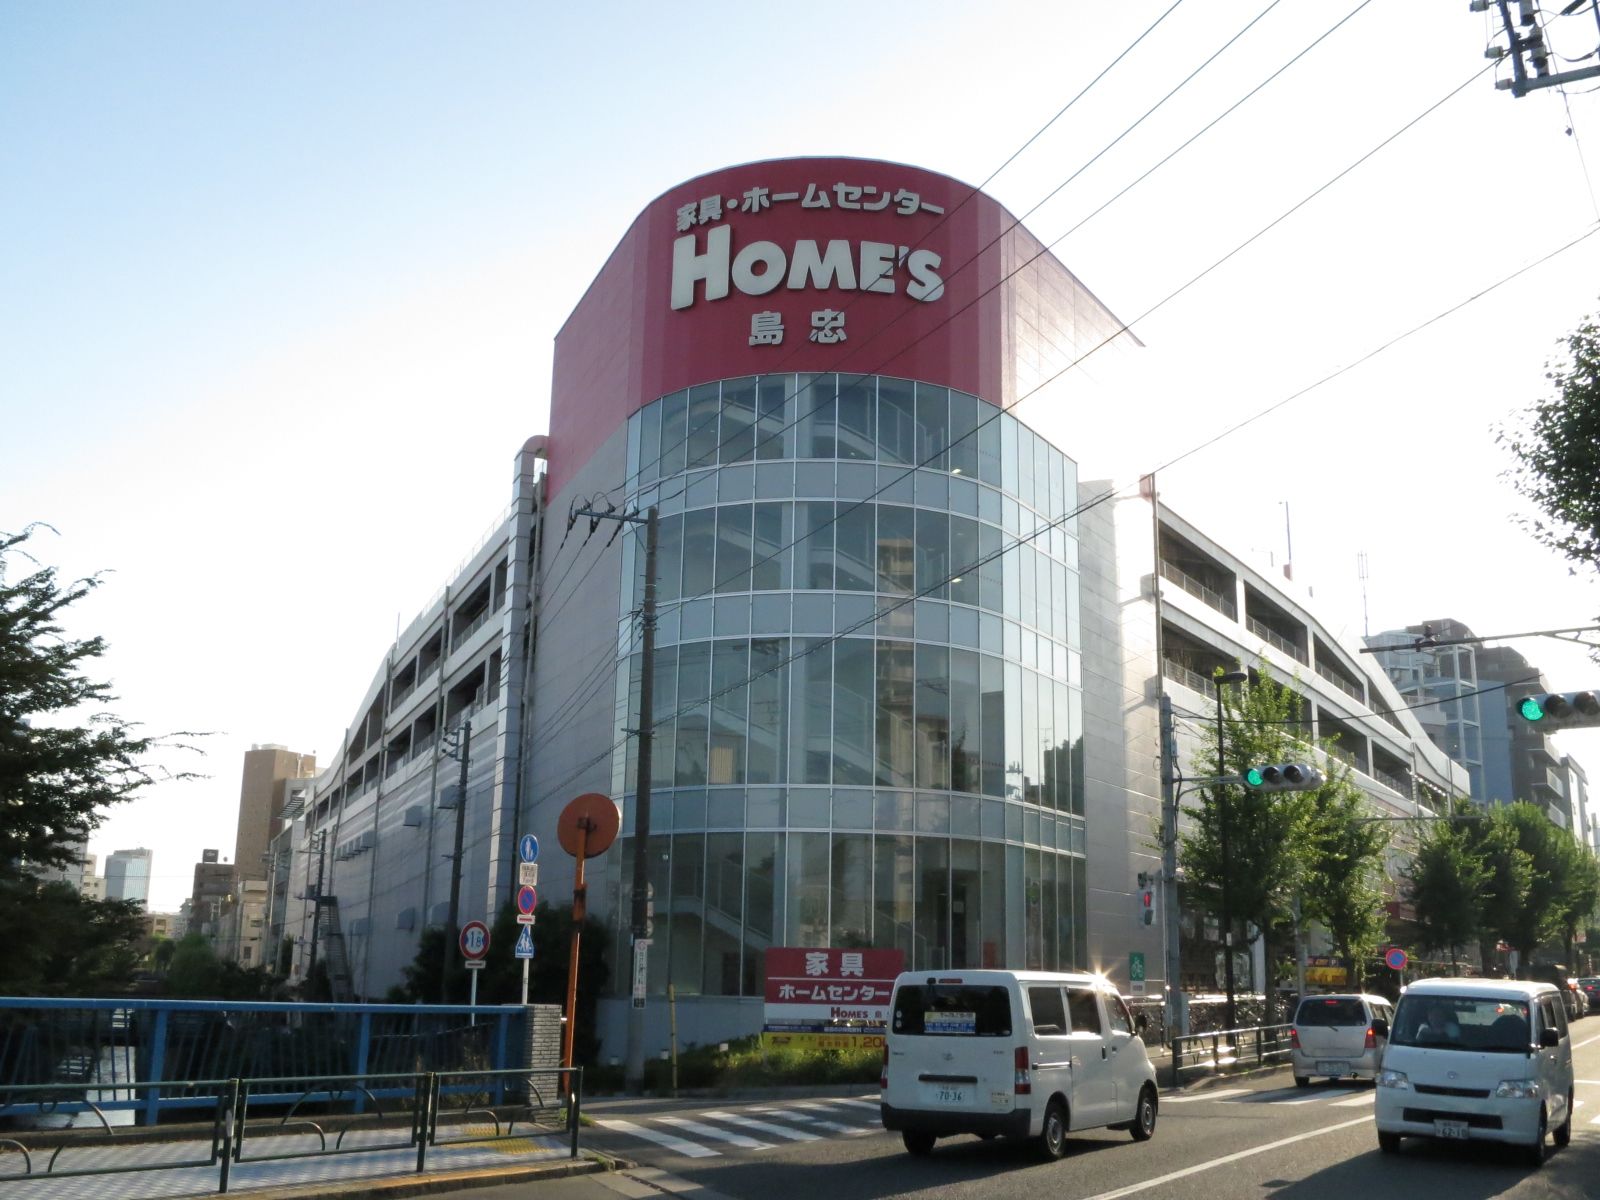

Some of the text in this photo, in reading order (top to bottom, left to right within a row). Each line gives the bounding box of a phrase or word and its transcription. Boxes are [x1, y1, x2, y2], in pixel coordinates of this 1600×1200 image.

[676, 182, 945, 232] 家具・ホームセンター
[670, 224, 945, 311] HOME'S
[748, 308, 847, 346] 島忠
[805, 952, 865, 977] 家具
[778, 983, 890, 1001] ホームセンター
